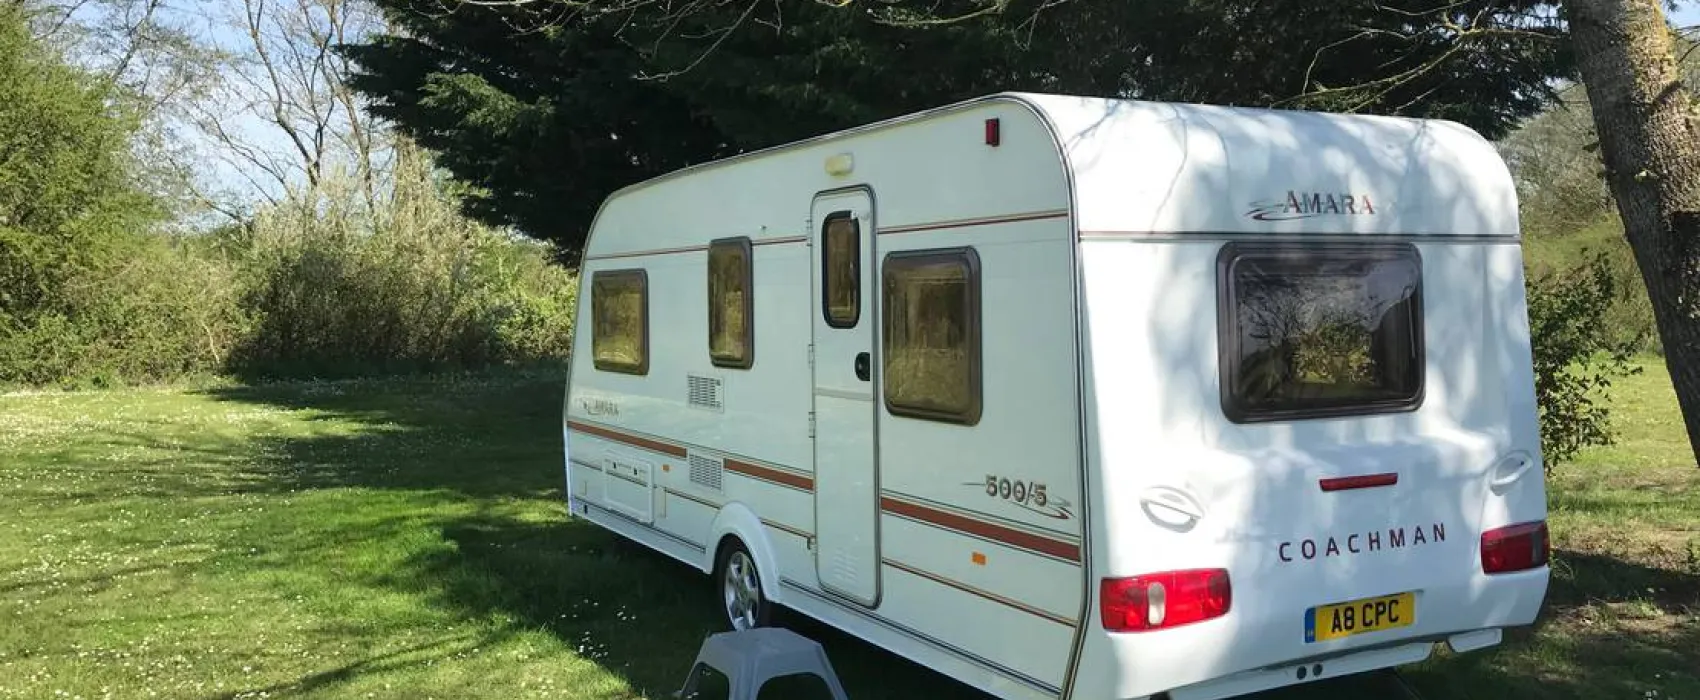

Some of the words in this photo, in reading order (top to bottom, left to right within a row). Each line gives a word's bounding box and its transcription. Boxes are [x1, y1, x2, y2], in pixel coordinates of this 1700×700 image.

[1283, 190, 1376, 215] AMARA
[985, 475, 1047, 507] 500/5
[1278, 523, 1446, 562] COACHMAN
[1331, 606, 1355, 634] A8
[1362, 599, 1399, 627] CPC
